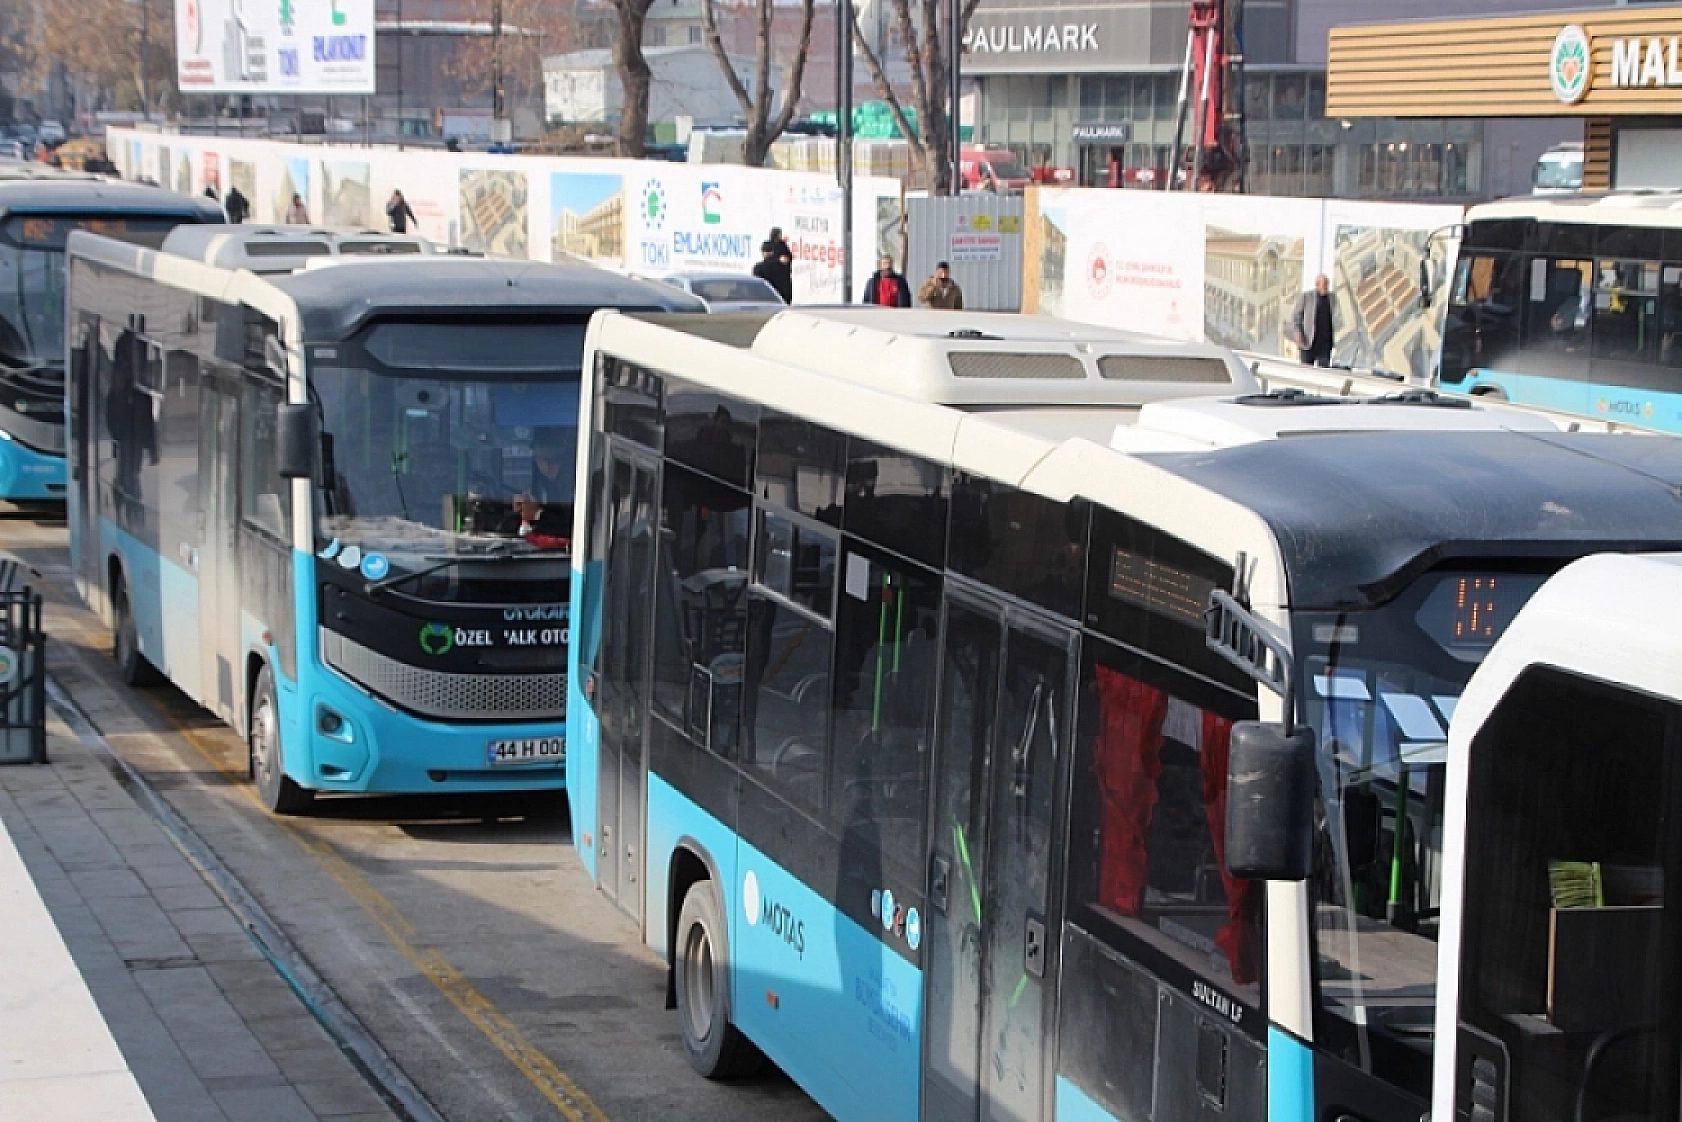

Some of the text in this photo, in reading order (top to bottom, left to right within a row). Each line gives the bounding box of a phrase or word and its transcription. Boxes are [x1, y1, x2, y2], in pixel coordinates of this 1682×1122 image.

[1610, 37, 1682, 87] MAL
[673, 231, 752, 258] EMLAK KONUT
[783, 235, 845, 269] eleceğe
[455, 627, 493, 646] ÖZEL
[496, 741, 517, 759] 44
[522, 739, 535, 757] H
[762, 893, 806, 962] MOTAŞ
[1192, 980, 1230, 1017] SULTAN
